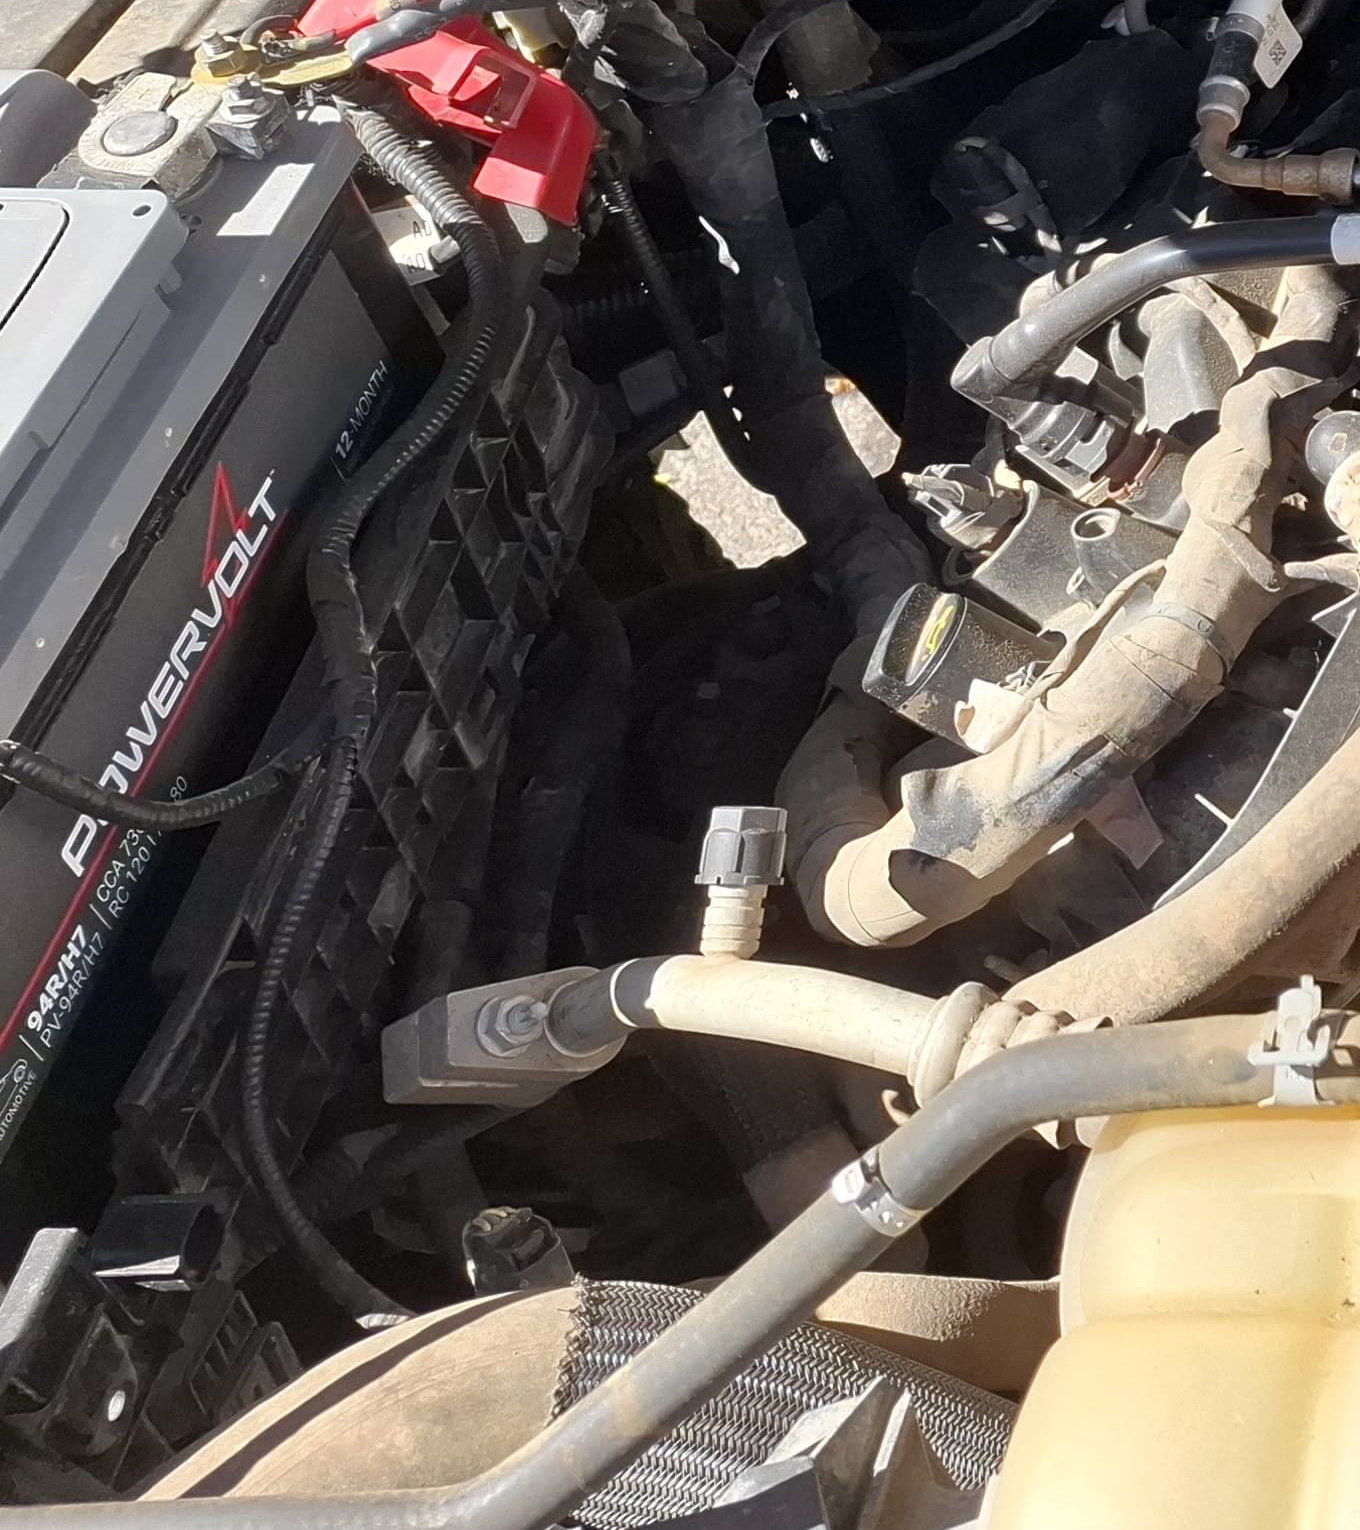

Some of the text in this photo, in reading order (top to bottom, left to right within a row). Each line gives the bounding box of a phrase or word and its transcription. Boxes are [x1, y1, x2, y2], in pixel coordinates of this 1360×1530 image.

[335, 359, 389, 459] 12-MONTH
[96, 857, 126, 904] CCA
[108, 848, 152, 919] RC 120
[27, 923, 88, 1032] 94R/H7
[39, 931, 104, 1049] PV-94R/H7
[0, 1070, 36, 1141] UTOMOTIVE
